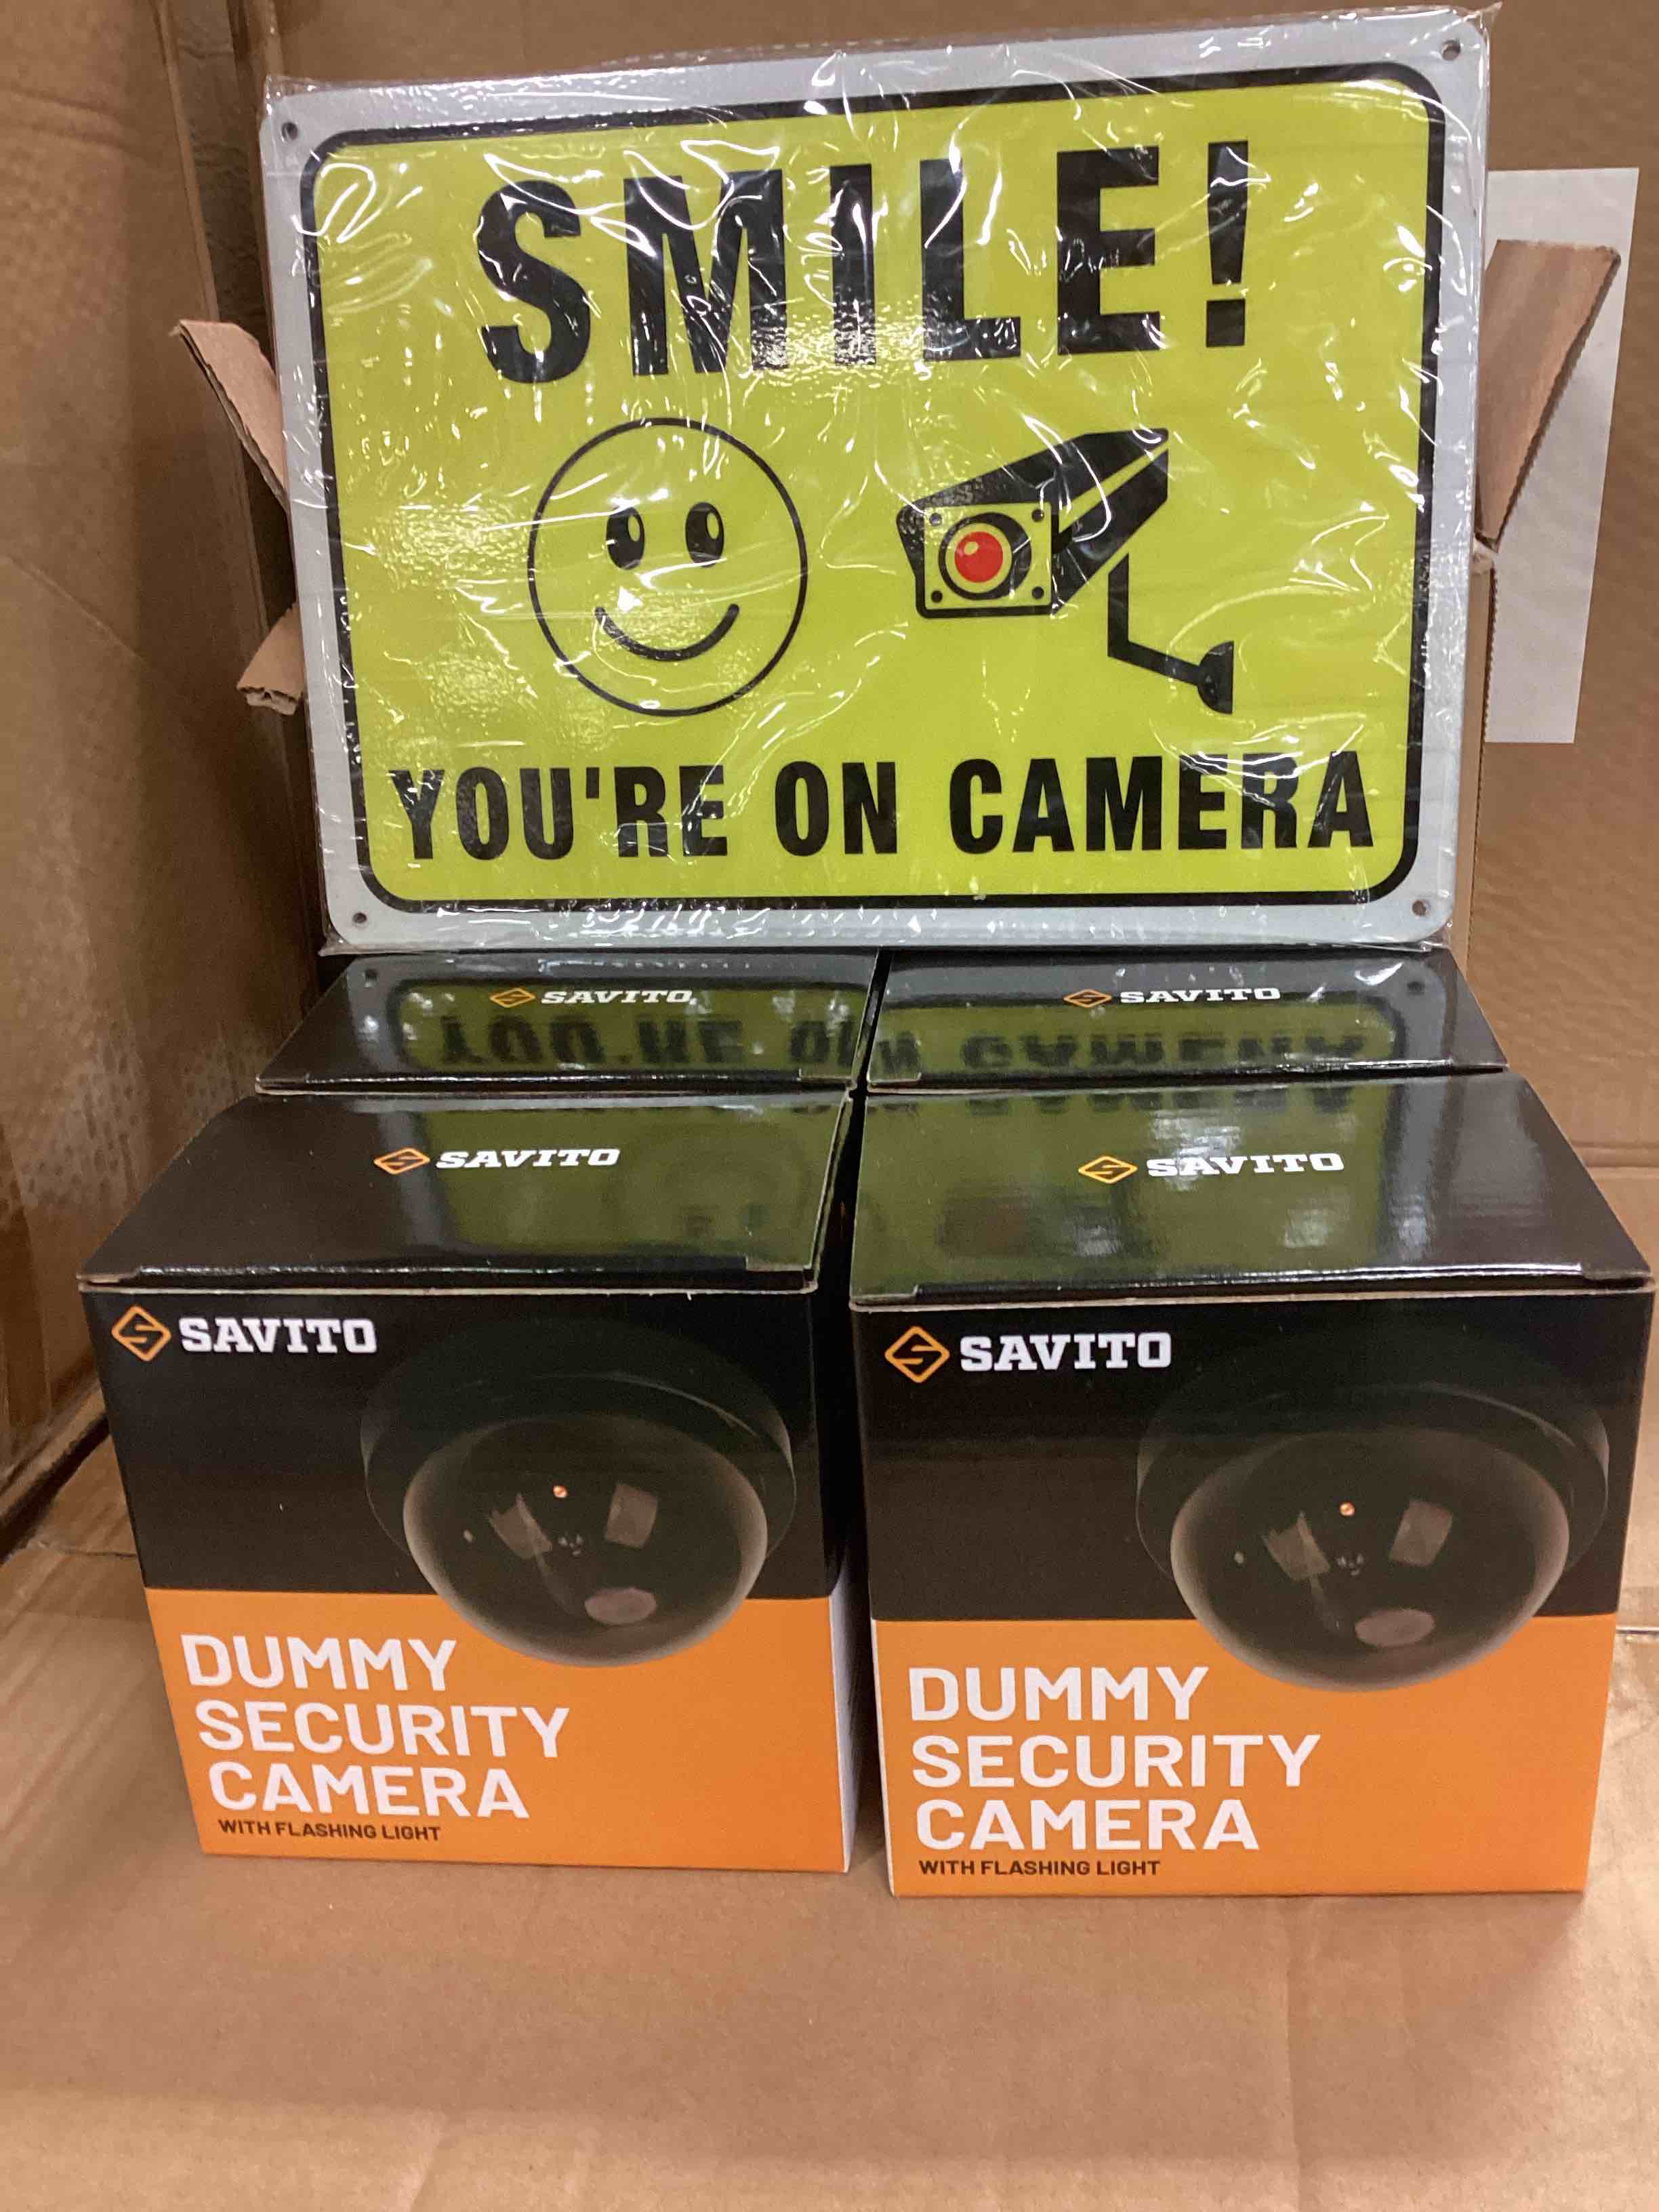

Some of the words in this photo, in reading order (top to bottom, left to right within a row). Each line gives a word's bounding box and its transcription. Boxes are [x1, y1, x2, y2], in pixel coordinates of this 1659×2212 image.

[476, 140, 1249, 384] SMILE!
[388, 764, 728, 862] YOU'RE
[774, 761, 899, 855] ON
[949, 751, 1376, 853] CAMERA
[540, 989, 694, 1006] SAVITO
[1120, 987, 1281, 1004] SAVITO
[435, 1148, 620, 1170] SAVITO
[1146, 1152, 1344, 1178] SAVITO
[178, 1317, 377, 1354] SAVITO
[960, 1332, 1172, 1372] SAVITO
[181, 1634, 457, 1692] DUMMY
[907, 1666, 1209, 1721] DUMMY
[197, 1700, 570, 1758] SECURITY
[912, 1734, 1321, 1788] SECURITY
[209, 1762, 530, 1819] CAMERA
[218, 1819, 272, 1835] WITH
[275, 1822, 377, 1839] FLASHING
[382, 1826, 441, 1841] LIGHT
[916, 1799, 1260, 1851] CAMERA
[919, 1860, 975, 1875] WITH
[981, 1860, 1091, 1875] FLASHING
[1097, 1860, 1161, 1875] LIGHT
